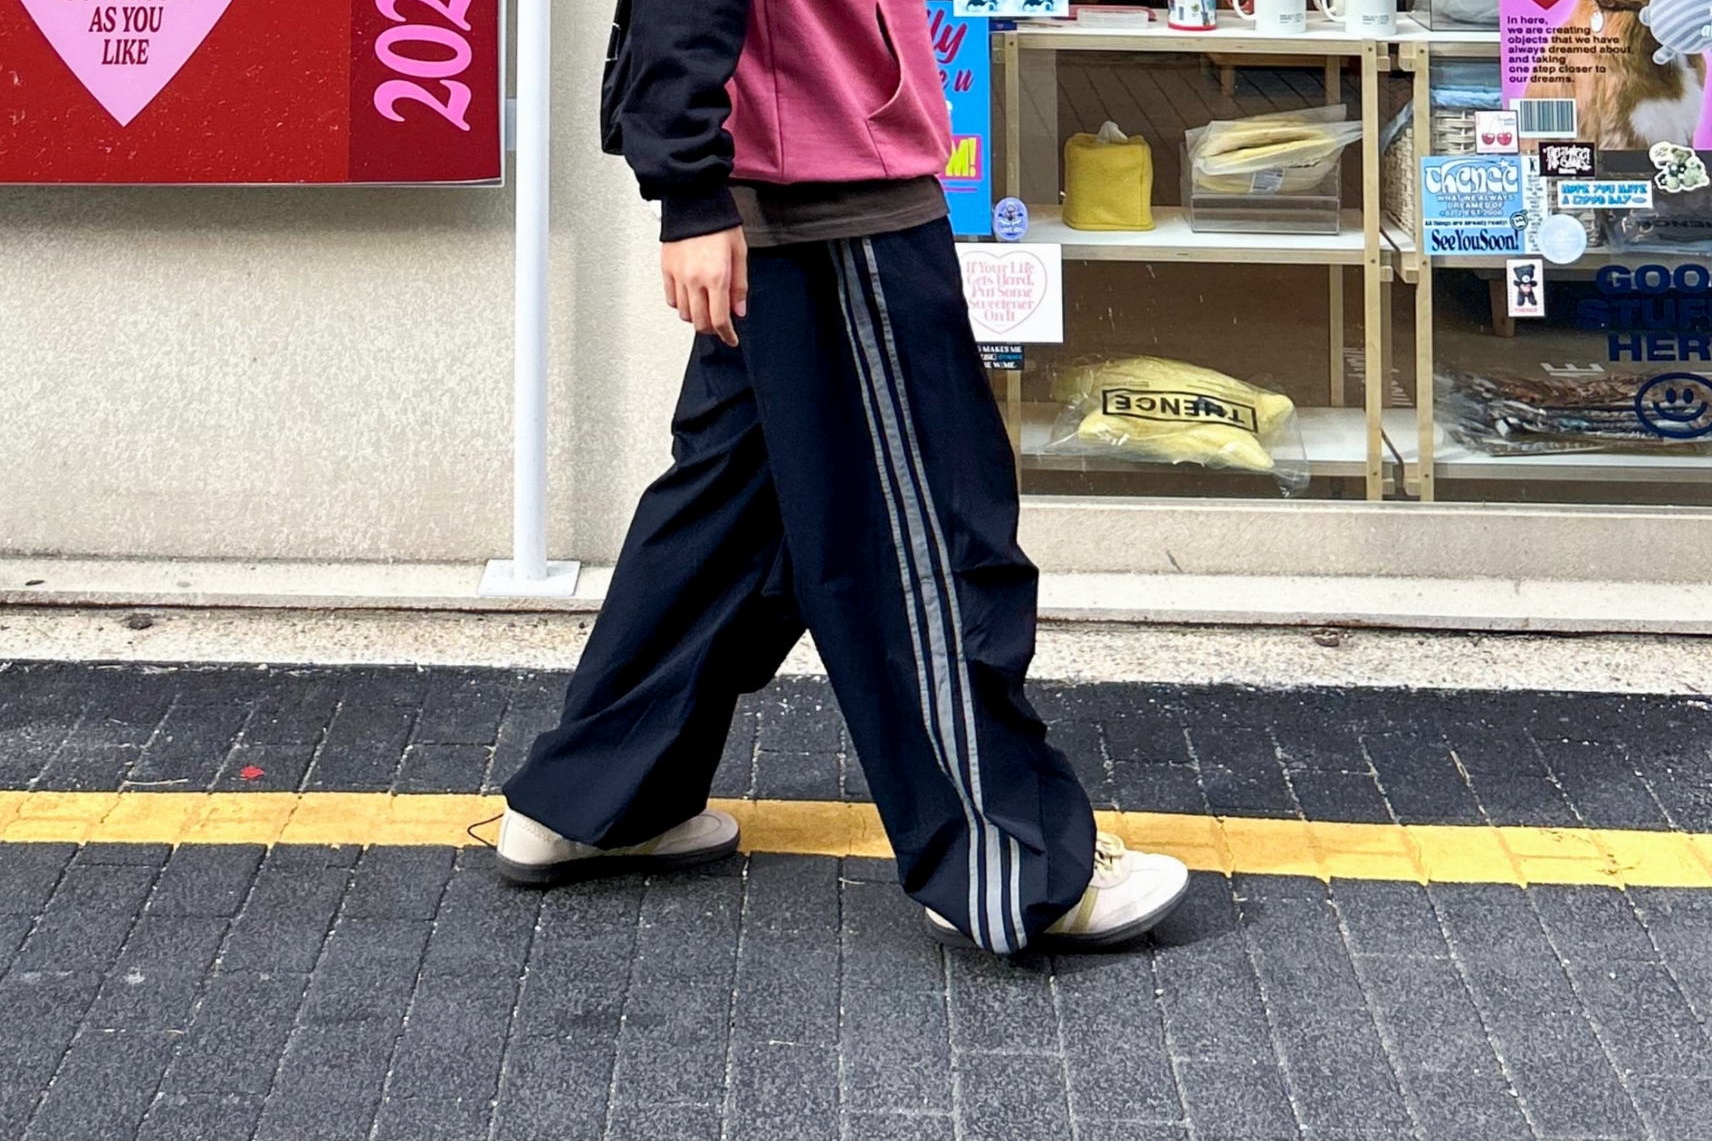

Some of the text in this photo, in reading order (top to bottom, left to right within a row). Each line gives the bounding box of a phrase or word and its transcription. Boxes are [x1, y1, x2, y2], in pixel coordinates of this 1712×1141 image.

[88, 7, 163, 33] AS YOU
[1507, 16, 1548, 26] In here,
[1546, 26, 1591, 35] creating
[1508, 36, 1548, 45] objects
[1551, 36, 1573, 44] that
[1593, 36, 1619, 44] have
[101, 39, 149, 66] LIKE
[1508, 46, 1546, 55] always
[1548, 46, 1597, 54] dreamed
[1532, 56, 1566, 65] taking
[1532, 66, 1556, 75] step
[1558, 65, 1592, 73] closer
[1595, 65, 1606, 73] to
[1530, 75, 1576, 83] dreams.
[967, 261, 1034, 274] If Your Life
[967, 274, 994, 286] Gets
[972, 286, 1034, 298] Put Some
[968, 300, 1035, 310] Sweetener
[984, 310, 1016, 322] On It
